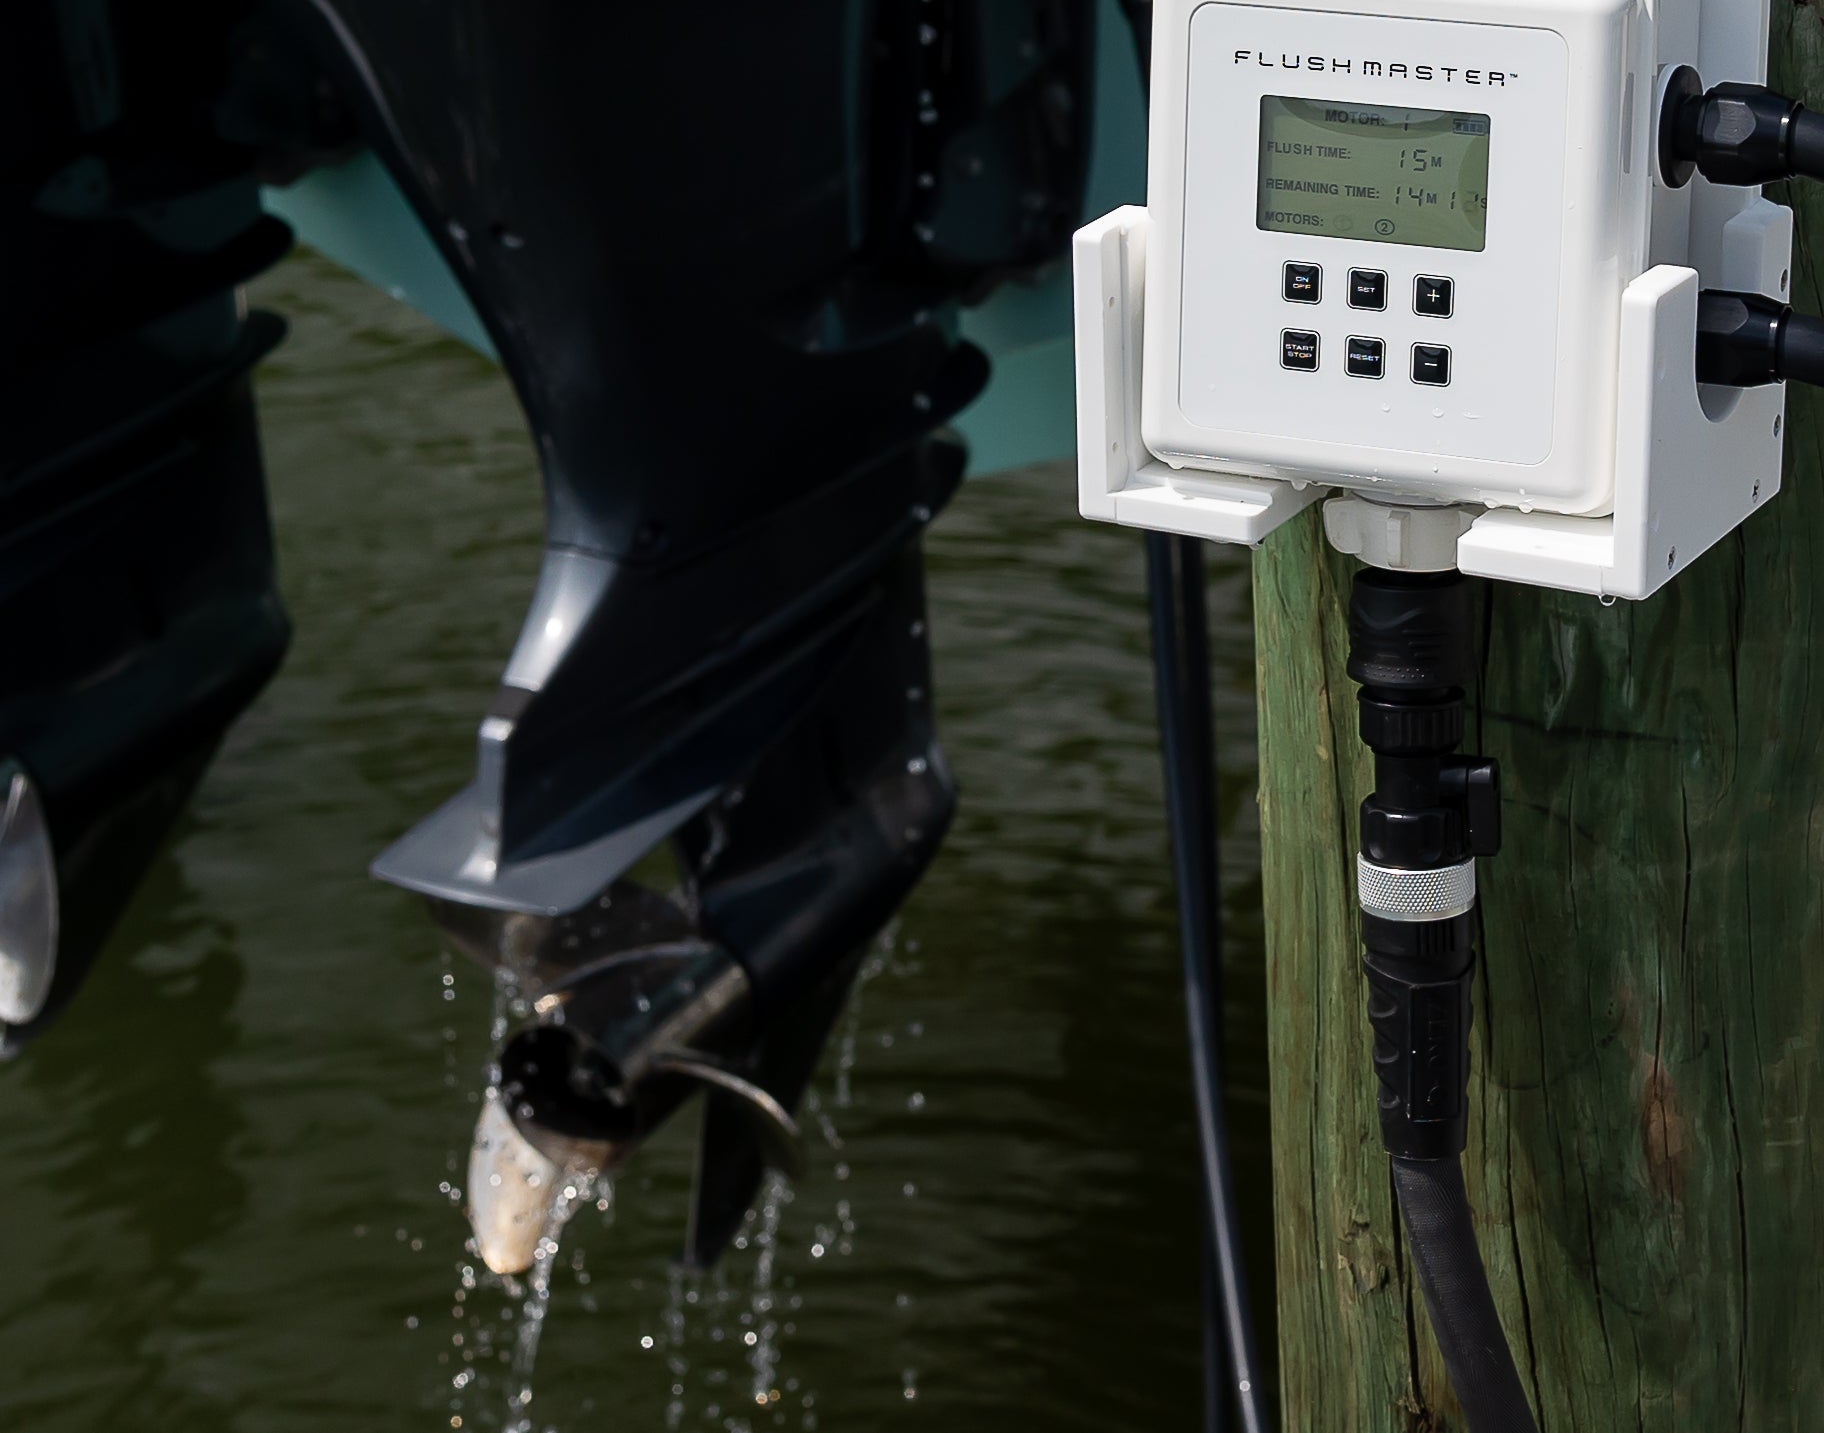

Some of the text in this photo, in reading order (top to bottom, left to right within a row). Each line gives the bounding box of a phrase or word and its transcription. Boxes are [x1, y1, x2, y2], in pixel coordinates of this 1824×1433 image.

[1325, 108, 1385, 127] MOTOR:
[1267, 141, 1313, 156] FLUSH
[1316, 145, 1352, 160] TIME:
[1265, 178, 1339, 195] REMAINING
[1345, 185, 1380, 199] TIME:
[1265, 211, 1324, 228] MOTORS:
[1295, 275, 1309, 284] ON
[1357, 286, 1375, 294] SET
[1285, 343, 1314, 352] START
[1287, 351, 1312, 359] STOP
[1349, 353, 1380, 362] RESET
